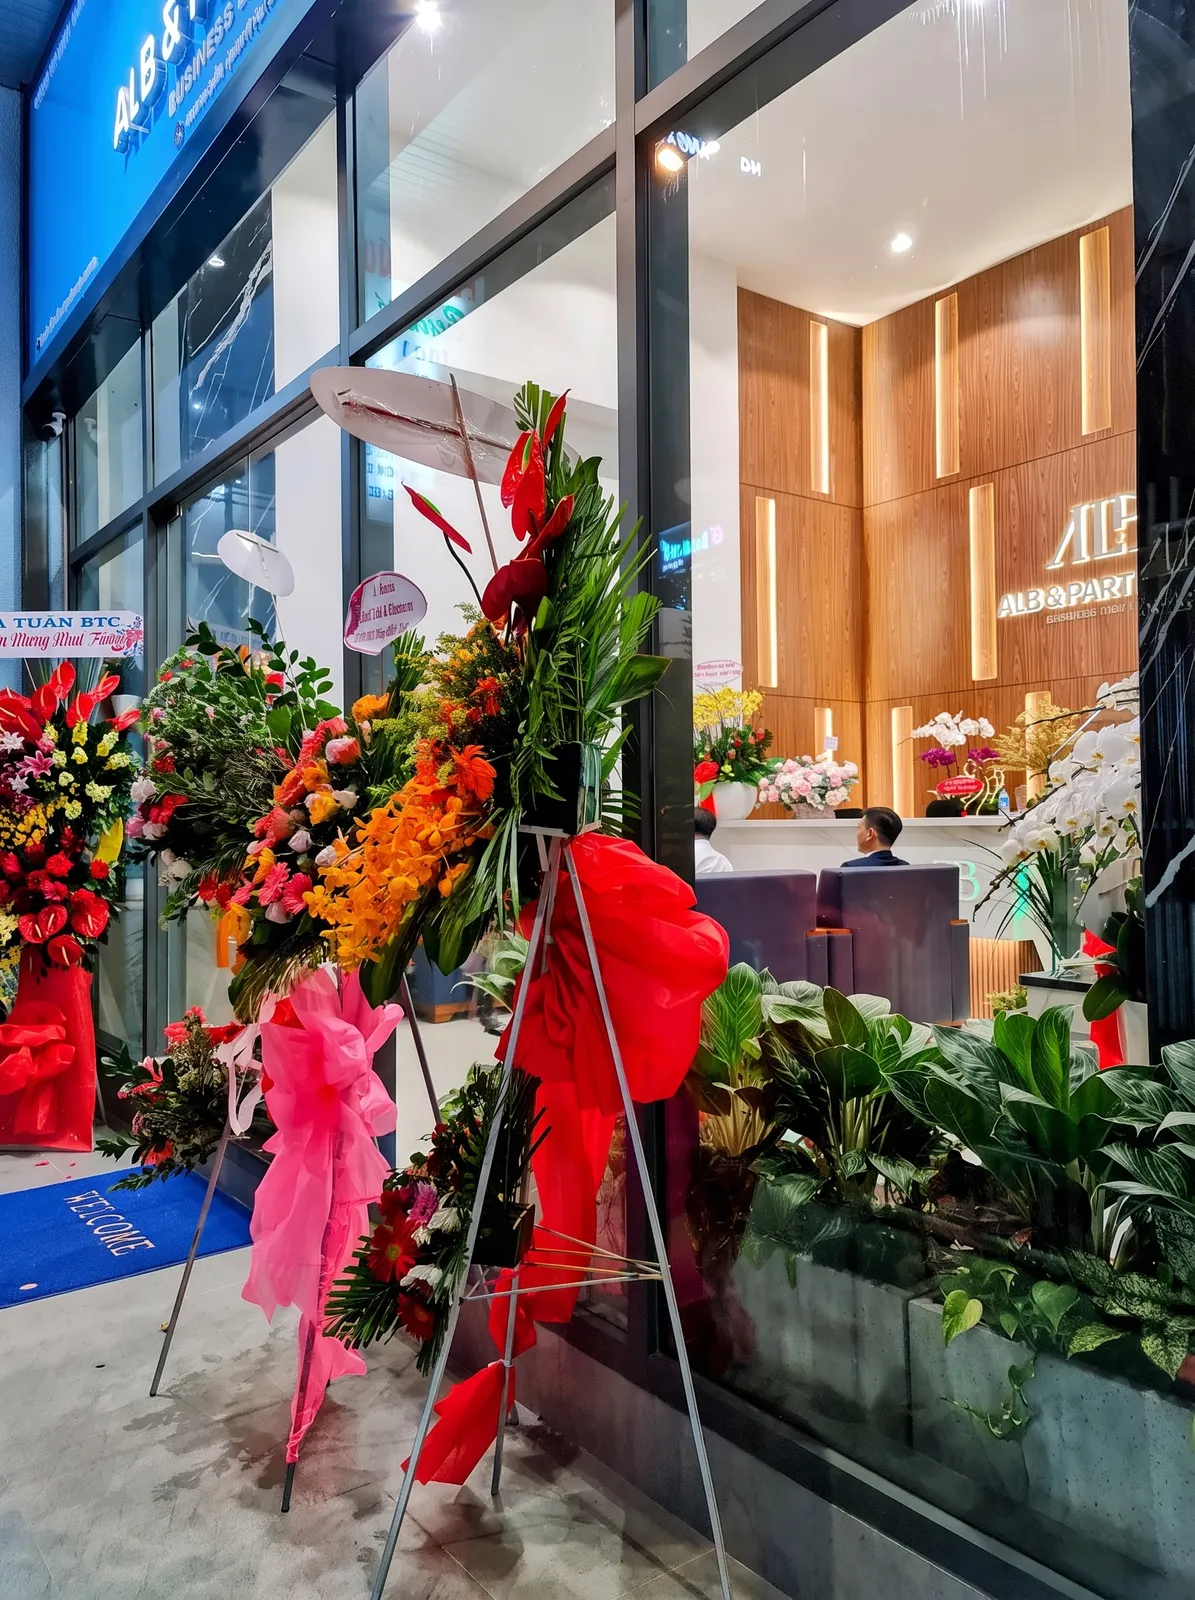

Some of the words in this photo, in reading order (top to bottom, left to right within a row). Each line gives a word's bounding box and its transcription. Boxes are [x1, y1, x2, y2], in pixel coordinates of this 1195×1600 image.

[113, 34, 156, 150] ALB
[162, 0, 181, 61] &
[168, 1, 235, 118] BUSINESS
[80, 616, 121, 628] BTC
[998, 588, 1043, 618] ALB
[63, 1189, 156, 1257] WELCOME
